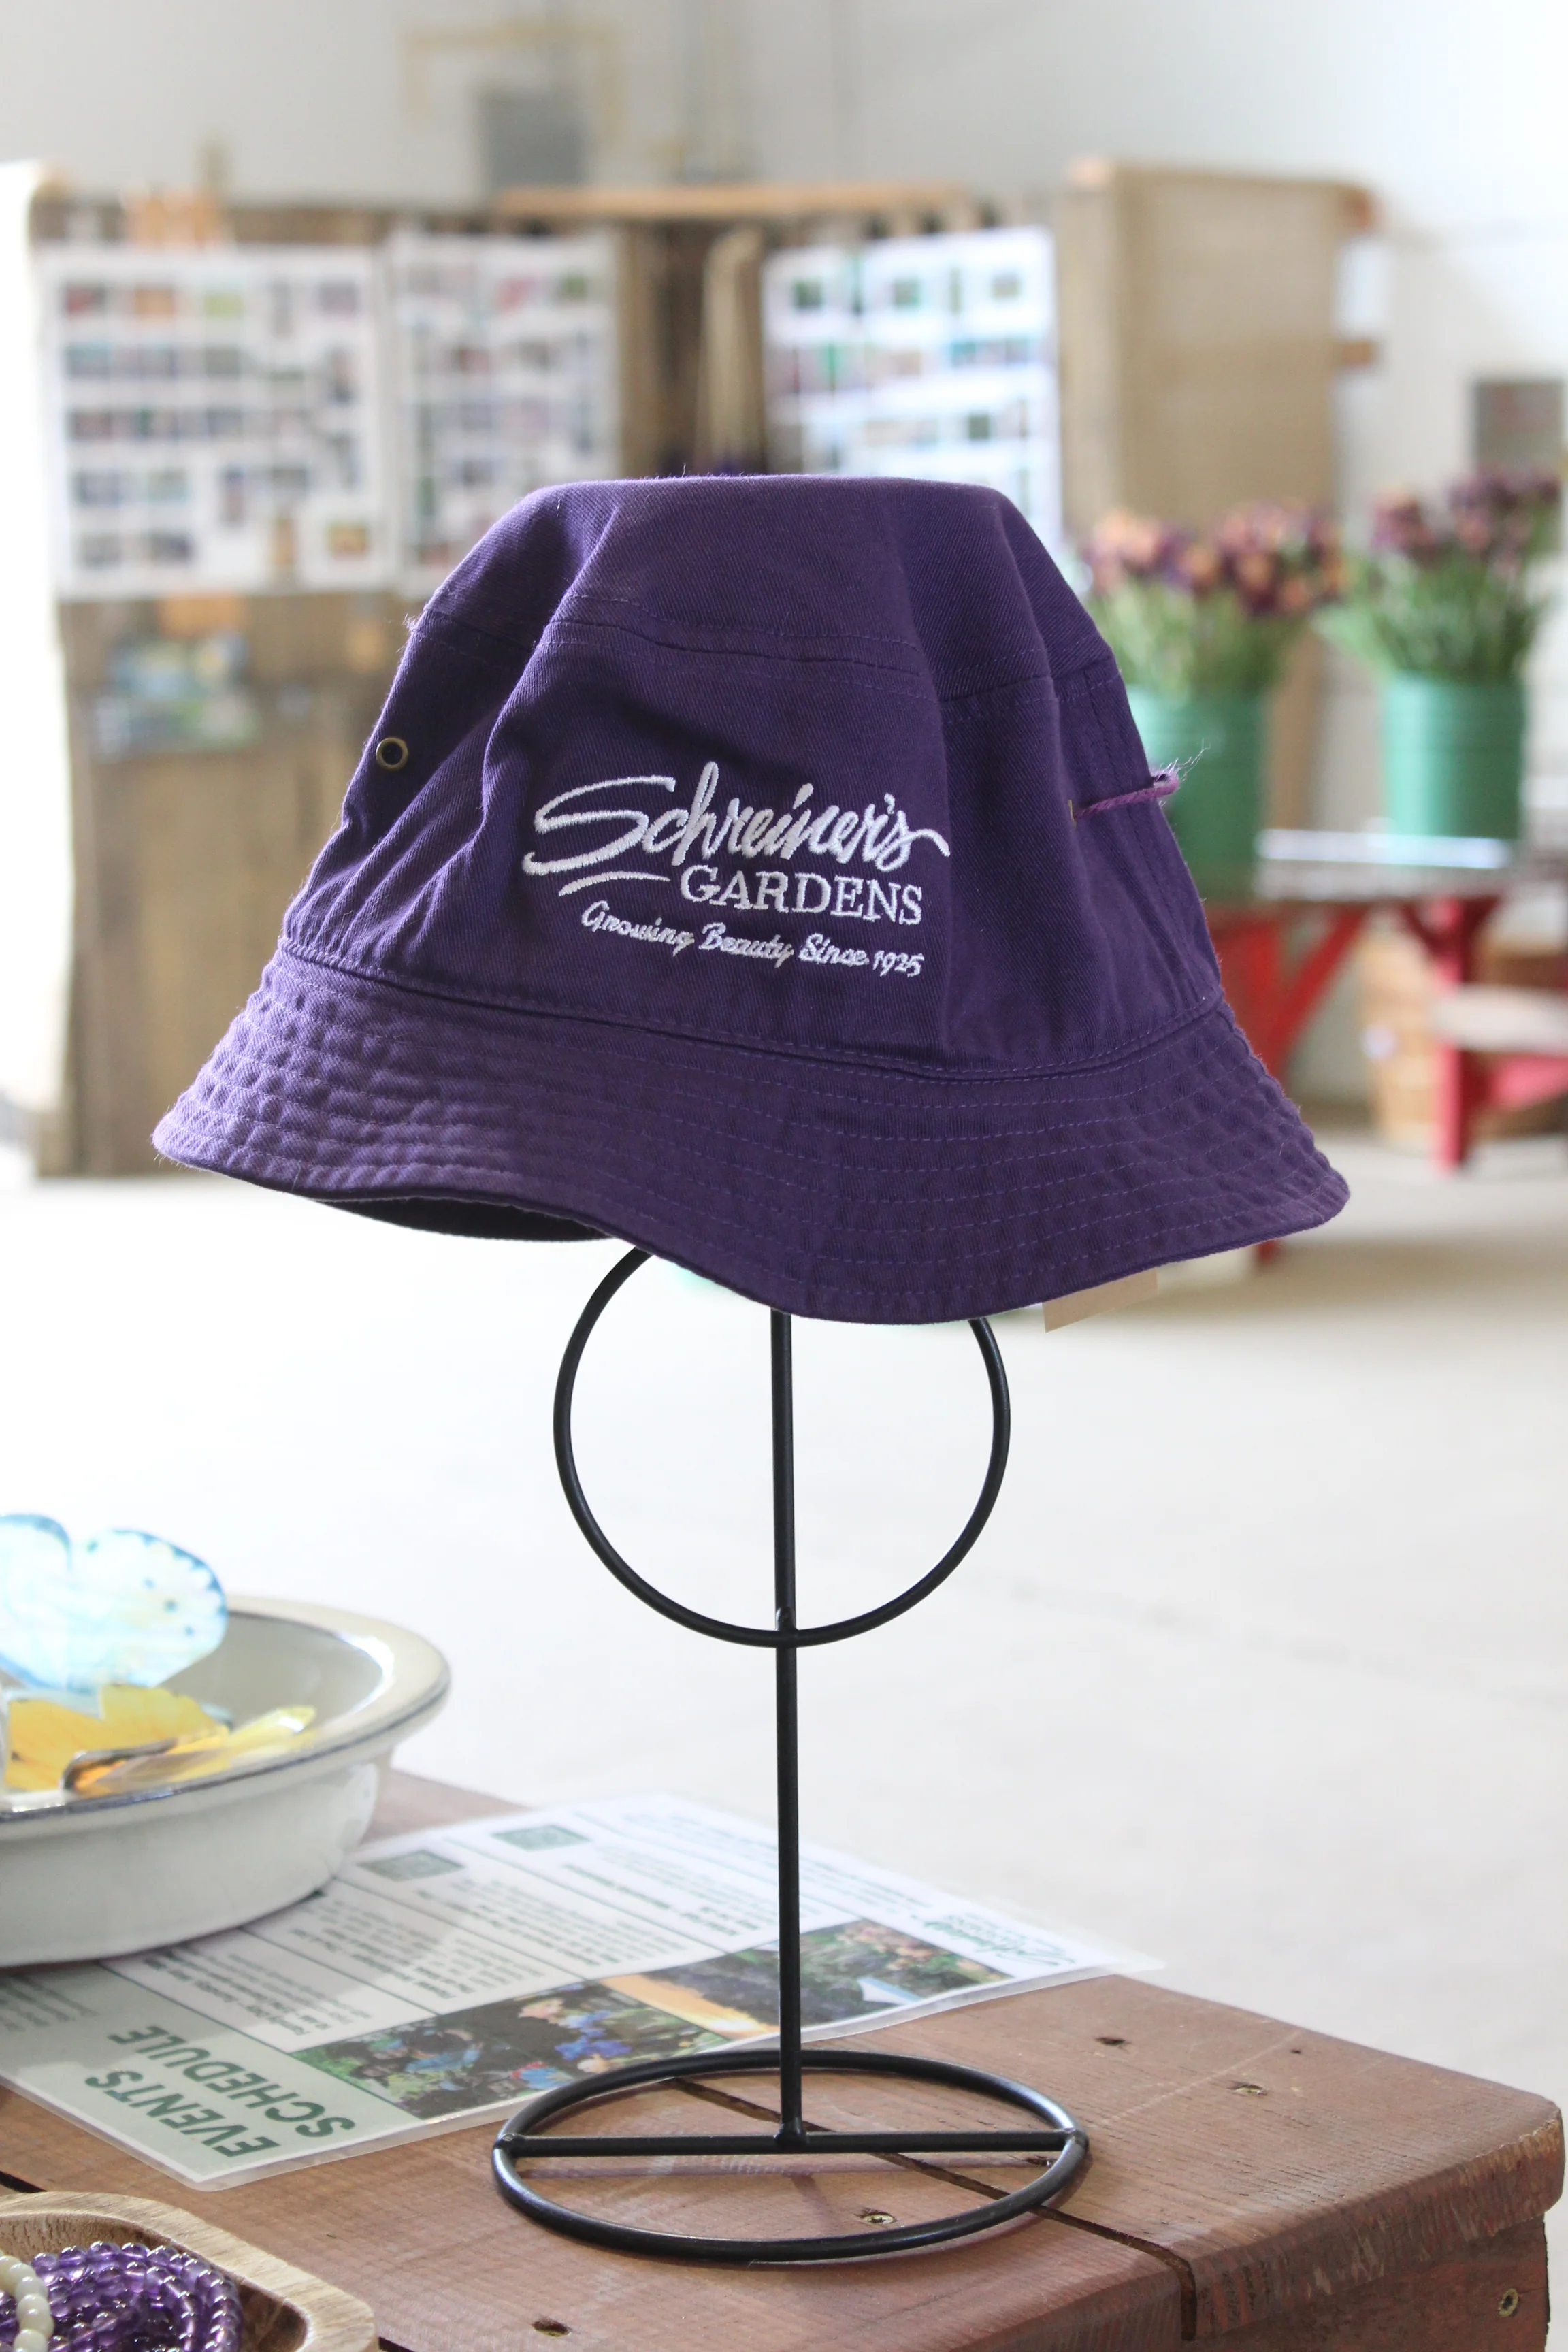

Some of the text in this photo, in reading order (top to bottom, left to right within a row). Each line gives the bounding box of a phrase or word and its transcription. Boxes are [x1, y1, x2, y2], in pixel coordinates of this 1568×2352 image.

[522, 761, 951, 872] Schreiner's
[581, 900, 925, 977] Growing Beauty Since 1925
[681, 864, 922, 926] GARDENS
[84, 2070, 280, 2157] EVENTS
[107, 2025, 355, 2137] SCHEDULE
